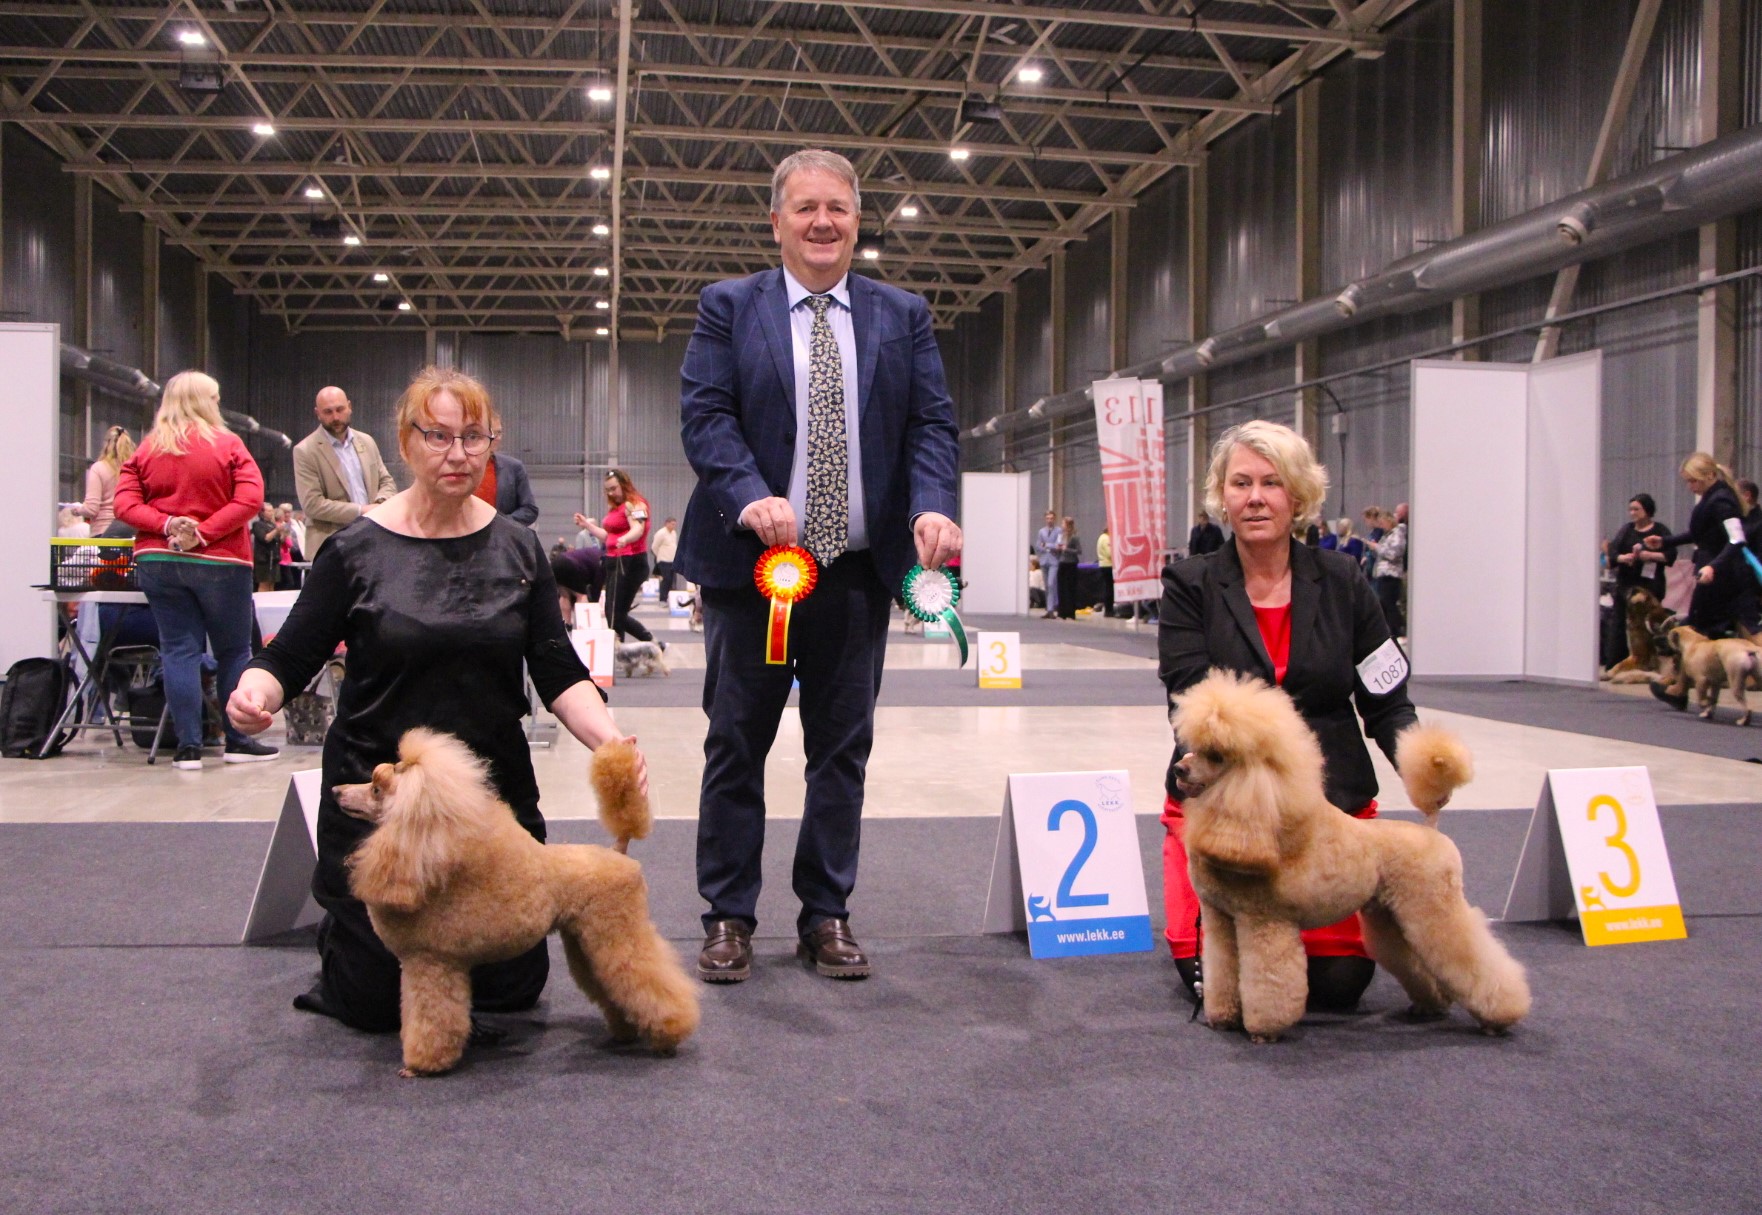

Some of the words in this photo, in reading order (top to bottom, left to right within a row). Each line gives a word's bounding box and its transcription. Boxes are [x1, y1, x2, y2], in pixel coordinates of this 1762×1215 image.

[584, 608, 591, 628] 1
[586, 639, 595, 672] 1
[990, 641, 1008, 675] 3
[1373, 657, 1404, 690] 1087
[1047, 799, 1109, 908] 2
[1587, 794, 1641, 897] 3
[1056, 928, 1125, 944] www.lekk.ee
